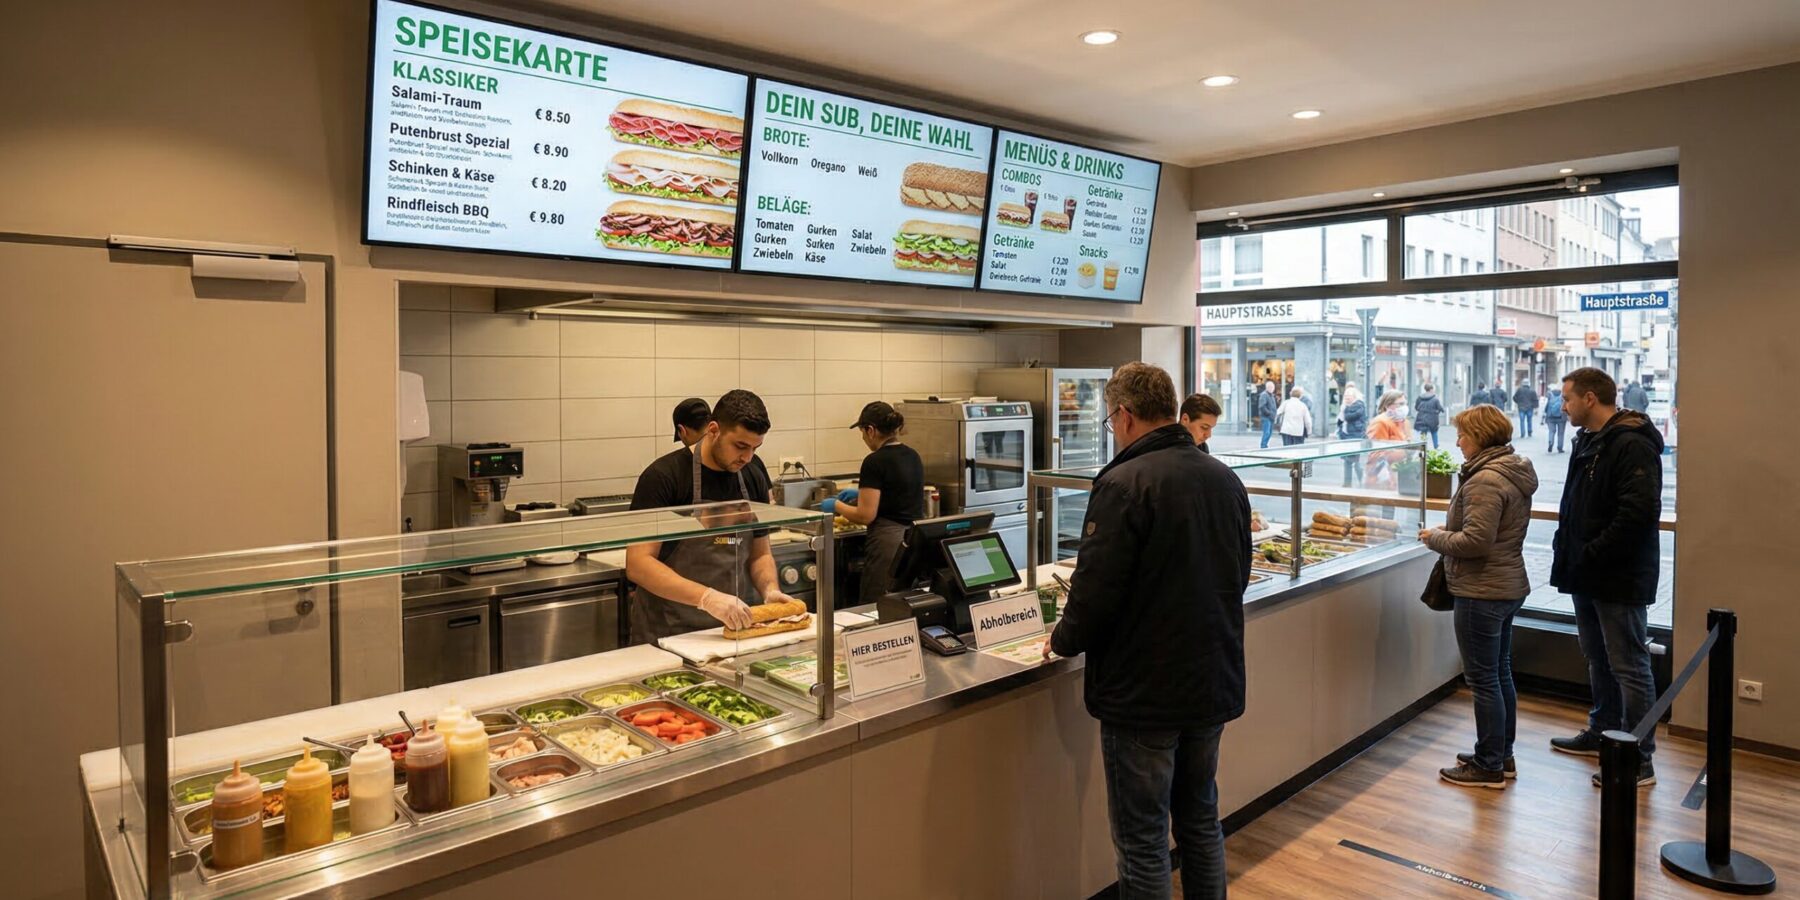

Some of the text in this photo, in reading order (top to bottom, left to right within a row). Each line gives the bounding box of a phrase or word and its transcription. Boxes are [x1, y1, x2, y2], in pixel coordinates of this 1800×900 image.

[395, 16, 609, 82] SPEISEKARTE
[393, 60, 499, 94] KLASSIKER
[391, 85, 481, 110] Salami-Traum
[535, 108, 571, 124] € 8.50
[766, 90, 974, 151] DEIN SUB, DEINE WAHL
[390, 122, 462, 143] Putenbrust
[465, 133, 510, 150] Spezial
[763, 126, 810, 148] BROTE:
[533, 143, 569, 158] € 8.90
[1004, 140, 1124, 180] MENÜS & DRINKS
[388, 159, 448, 177] Schinken
[452, 167, 461, 179] &
[464, 168, 495, 183] Käse
[761, 150, 878, 178] Vollkorn Oregano Weiß
[531, 177, 567, 191] € 8.20
[1002, 168, 1042, 186] COMBOS
[1088, 184, 1123, 201] Getränke
[387, 196, 490, 219] Rindfleisch BBQ
[757, 195, 811, 215] BELÄGE:
[529, 211, 565, 225] € 9.80
[755, 217, 873, 240] Tomaten Gurken Salat
[754, 233, 787, 245] Gurken
[850, 243, 886, 255] Zwiebeln
[994, 233, 1034, 249] Getränke
[1079, 245, 1108, 258] Snacks
[753, 247, 826, 263] Zwiebeln Käse
[1206, 304, 1293, 319] HAUPTSTRASSE
[980, 606, 1038, 631] Abholbereich
[851, 644, 871, 657] HIER
[872, 635, 915, 653] BESTELLEN
